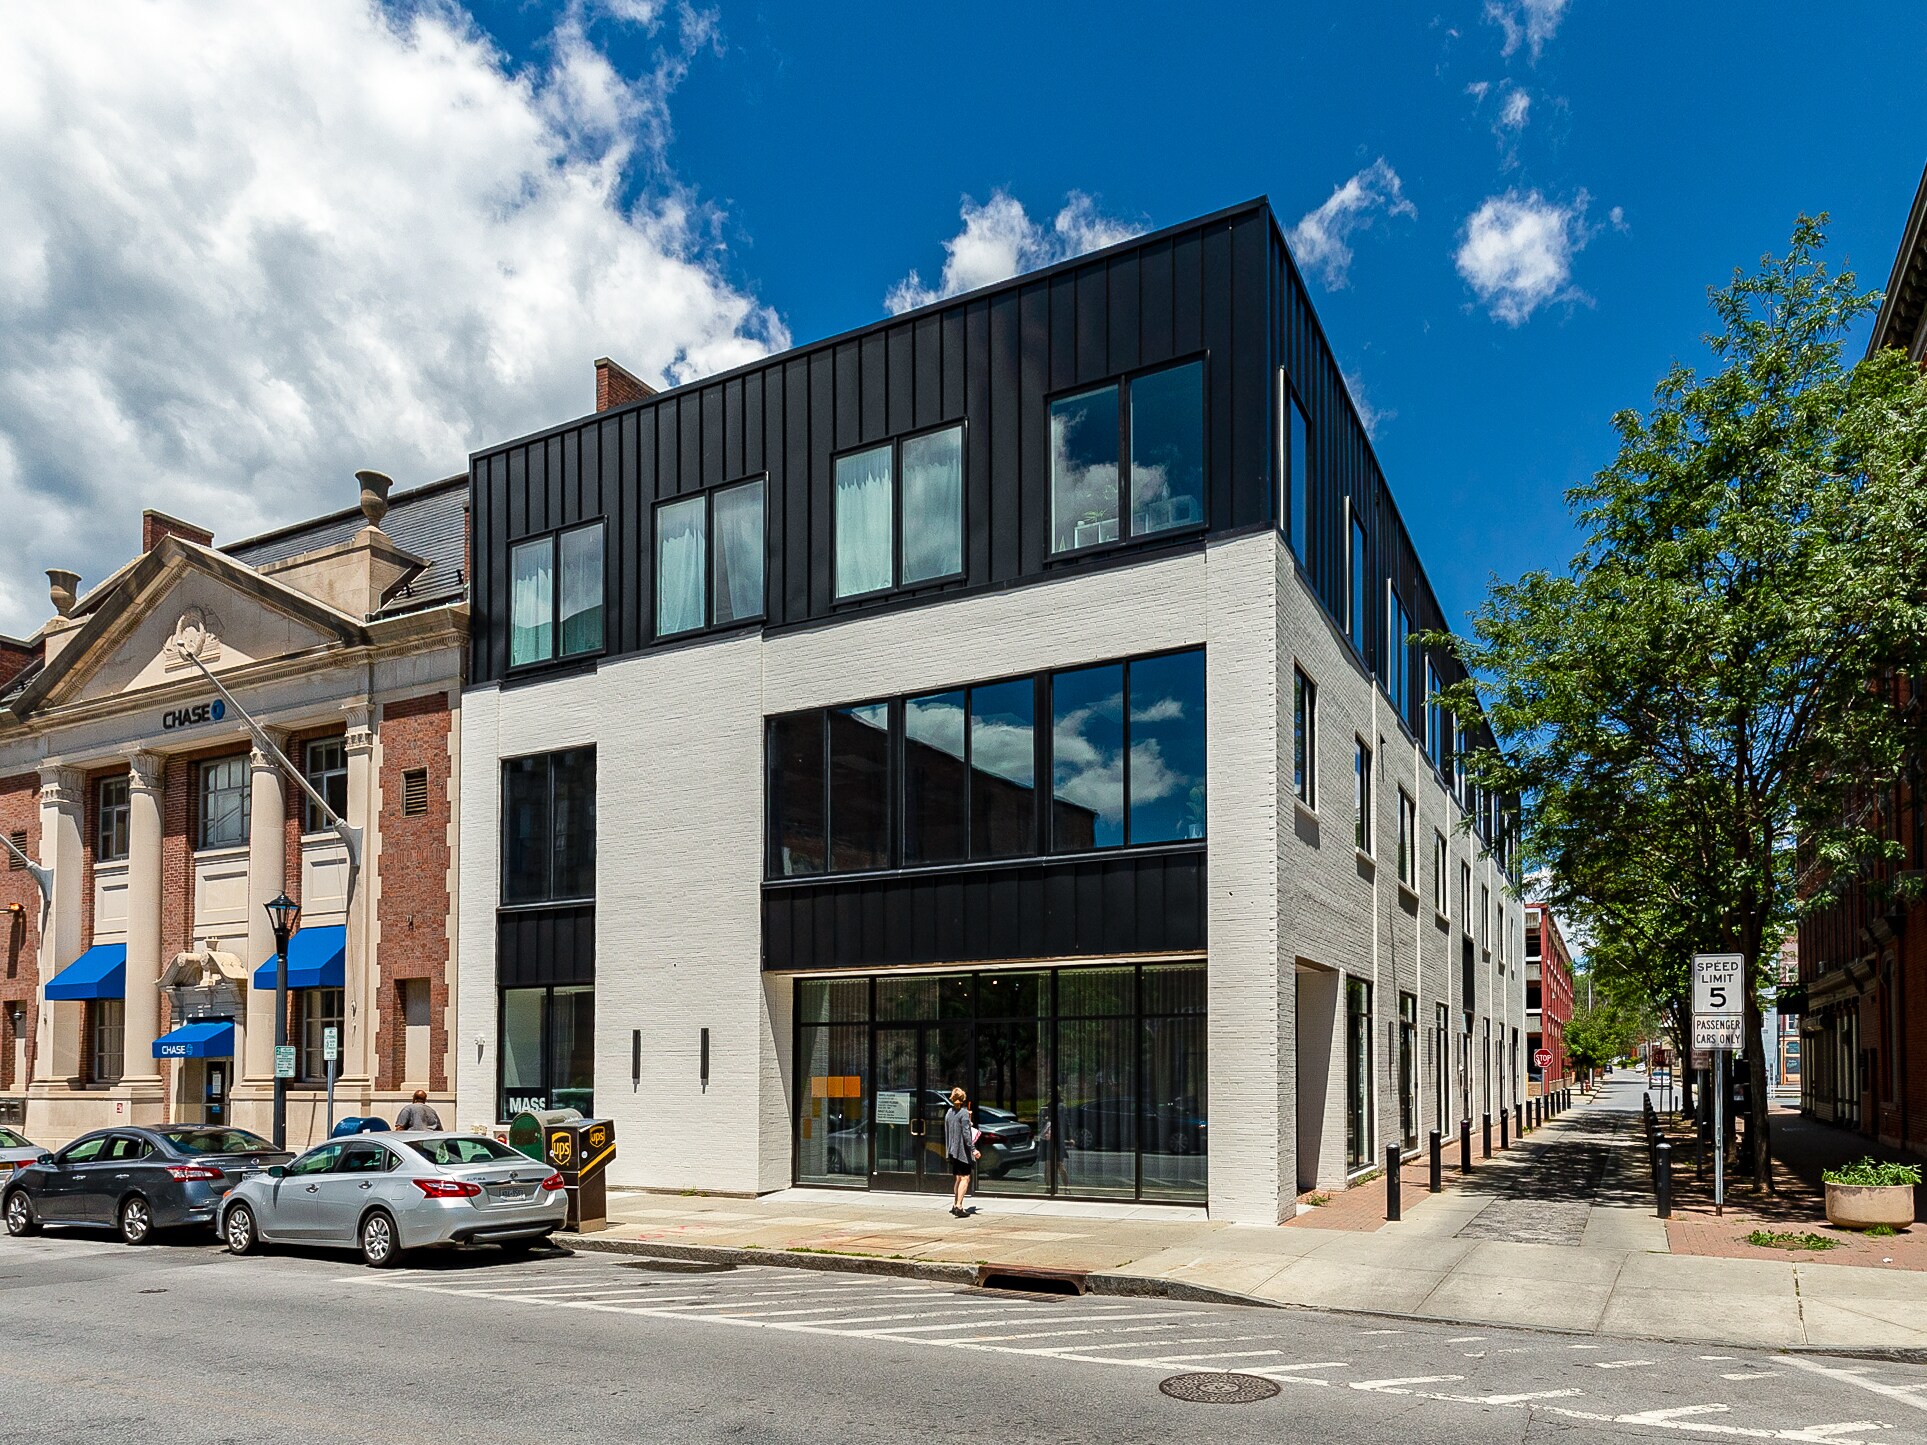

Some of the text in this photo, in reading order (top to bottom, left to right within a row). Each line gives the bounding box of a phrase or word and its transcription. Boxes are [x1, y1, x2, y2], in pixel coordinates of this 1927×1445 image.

[163, 703, 210, 729] CHASE
[1697, 962, 1739, 971] SPEED
[1701, 974, 1734, 983] LIMIT
[1709, 987, 1727, 1008] 5
[1696, 1020, 1740, 1030] PASSENGER
[1696, 1034, 1740, 1044] CARS ONLY
[161, 1045, 186, 1054] CHASE
[1535, 1054, 1552, 1062] STOP
[591, 1131, 605, 1145] ups
[553, 1142, 570, 1159] ups
